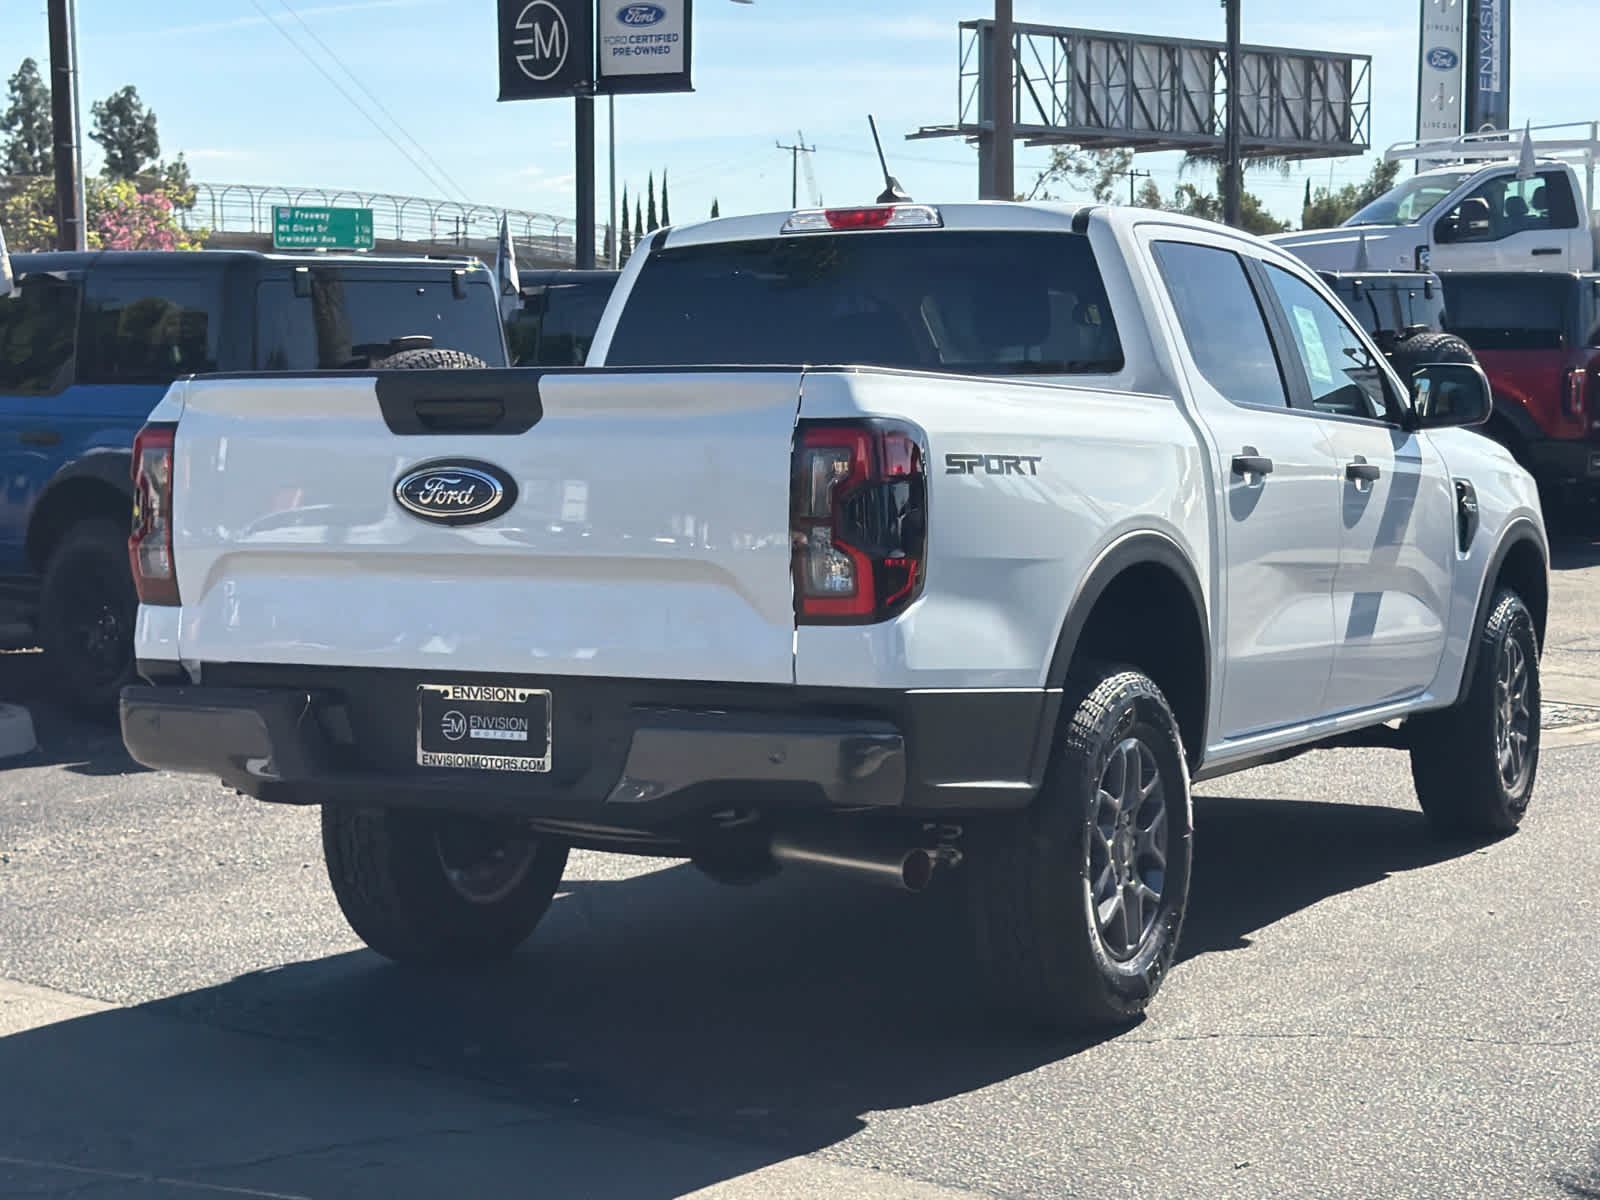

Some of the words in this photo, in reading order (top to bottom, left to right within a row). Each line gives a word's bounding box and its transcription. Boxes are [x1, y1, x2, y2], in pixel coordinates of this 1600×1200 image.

[624, 7, 657, 25] Ford
[628, 33, 679, 45] CERTIFIED
[612, 45, 671, 57] PRE-OWNED
[294, 211, 330, 222] Freeway
[292, 224, 314, 232] Olive
[278, 234, 317, 243] Irwindale
[945, 453, 1043, 476] SPORT
[418, 477, 476, 505] Ford
[452, 686, 517, 701] ENVISION
[469, 715, 529, 731] ENVISION
[422, 754, 546, 771] ENVISIONMOTORS.COM
